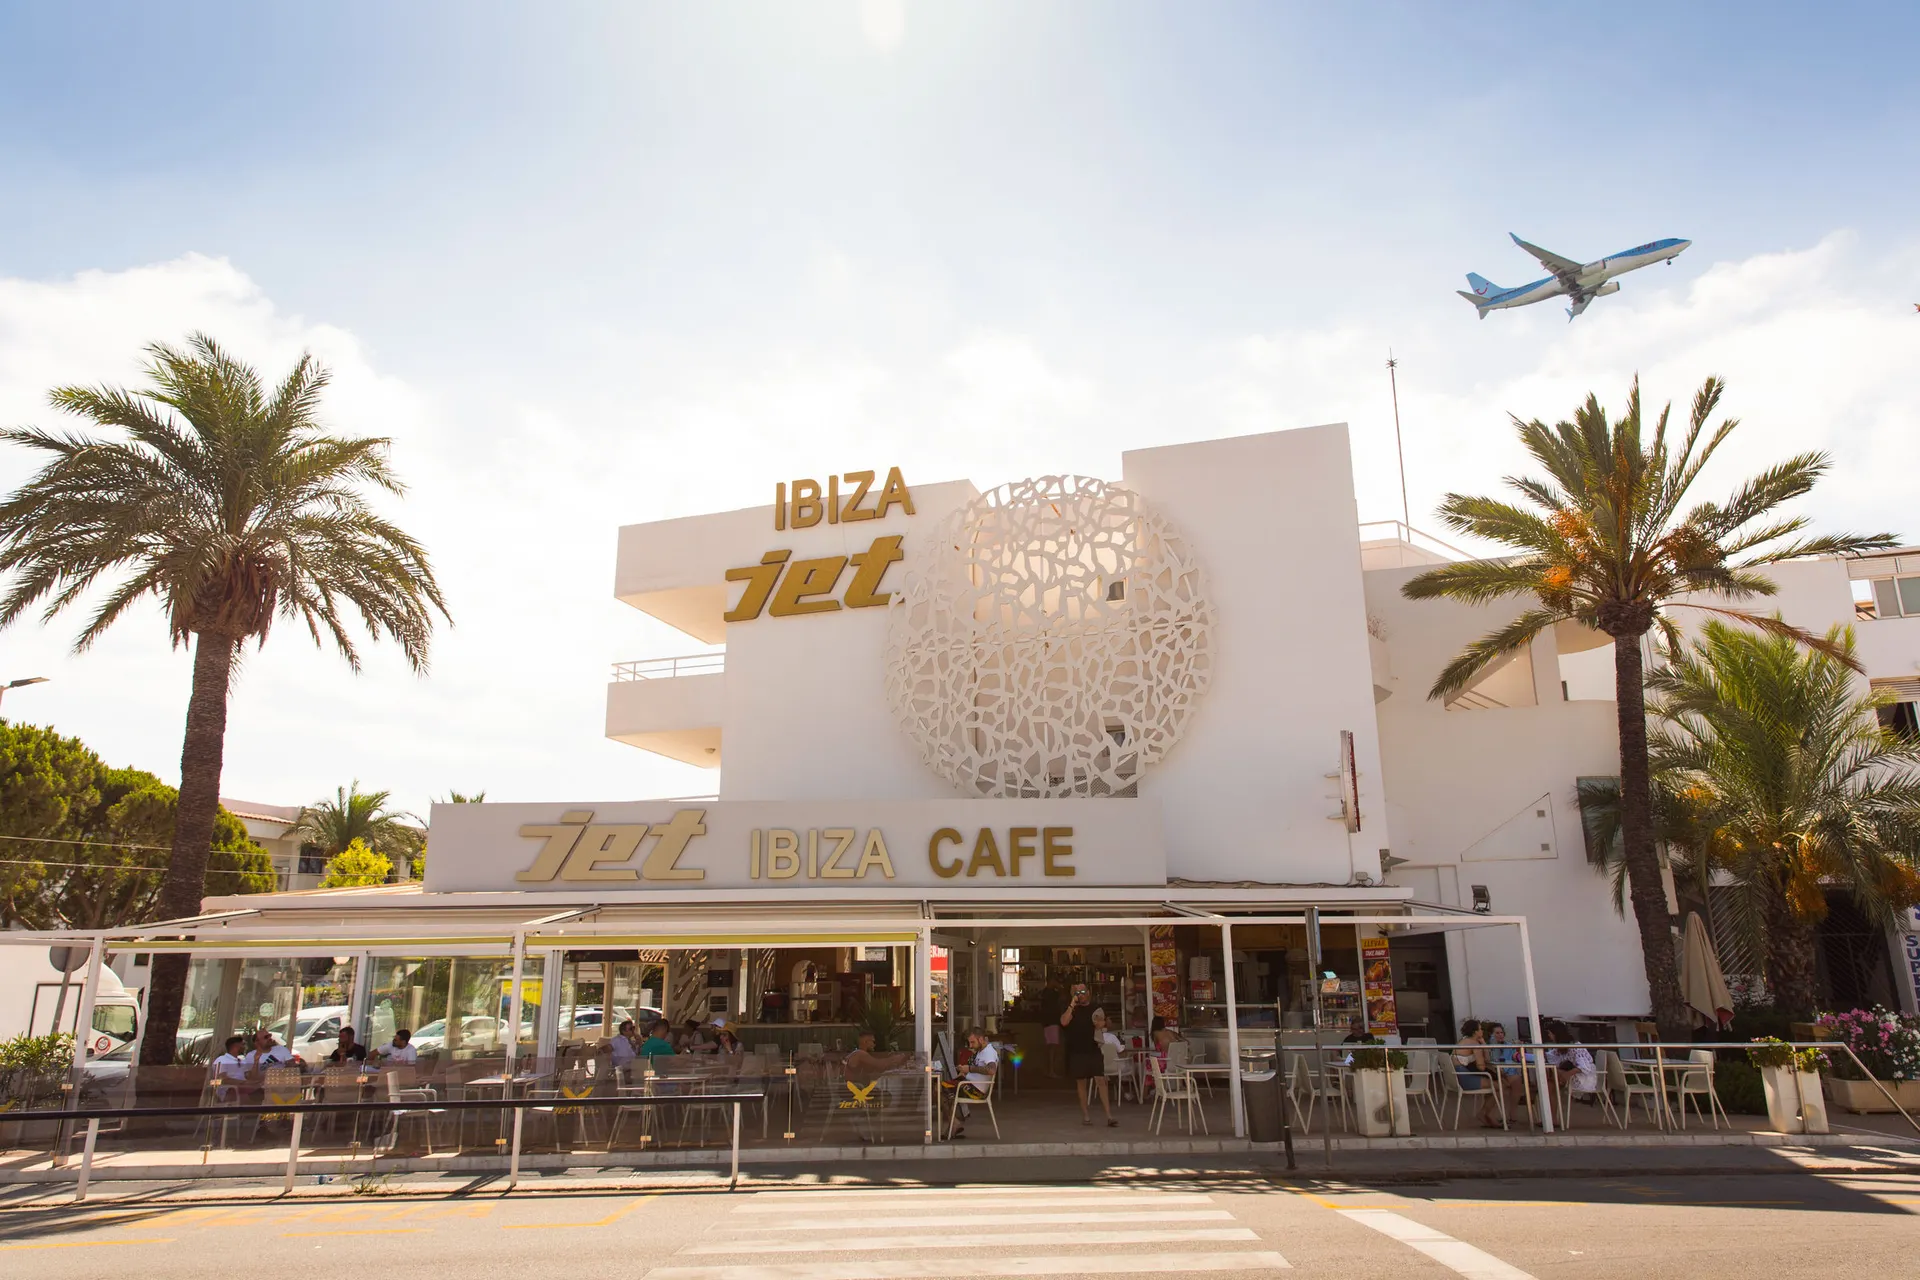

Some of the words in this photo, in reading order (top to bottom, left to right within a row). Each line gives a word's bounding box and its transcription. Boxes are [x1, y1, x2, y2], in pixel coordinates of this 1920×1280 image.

[775, 466, 916, 531] IBIZA
[724, 535, 905, 622] jet
[515, 809, 707, 882] jet
[751, 829, 895, 879] IBIZA
[929, 827, 1075, 878] CAFE
